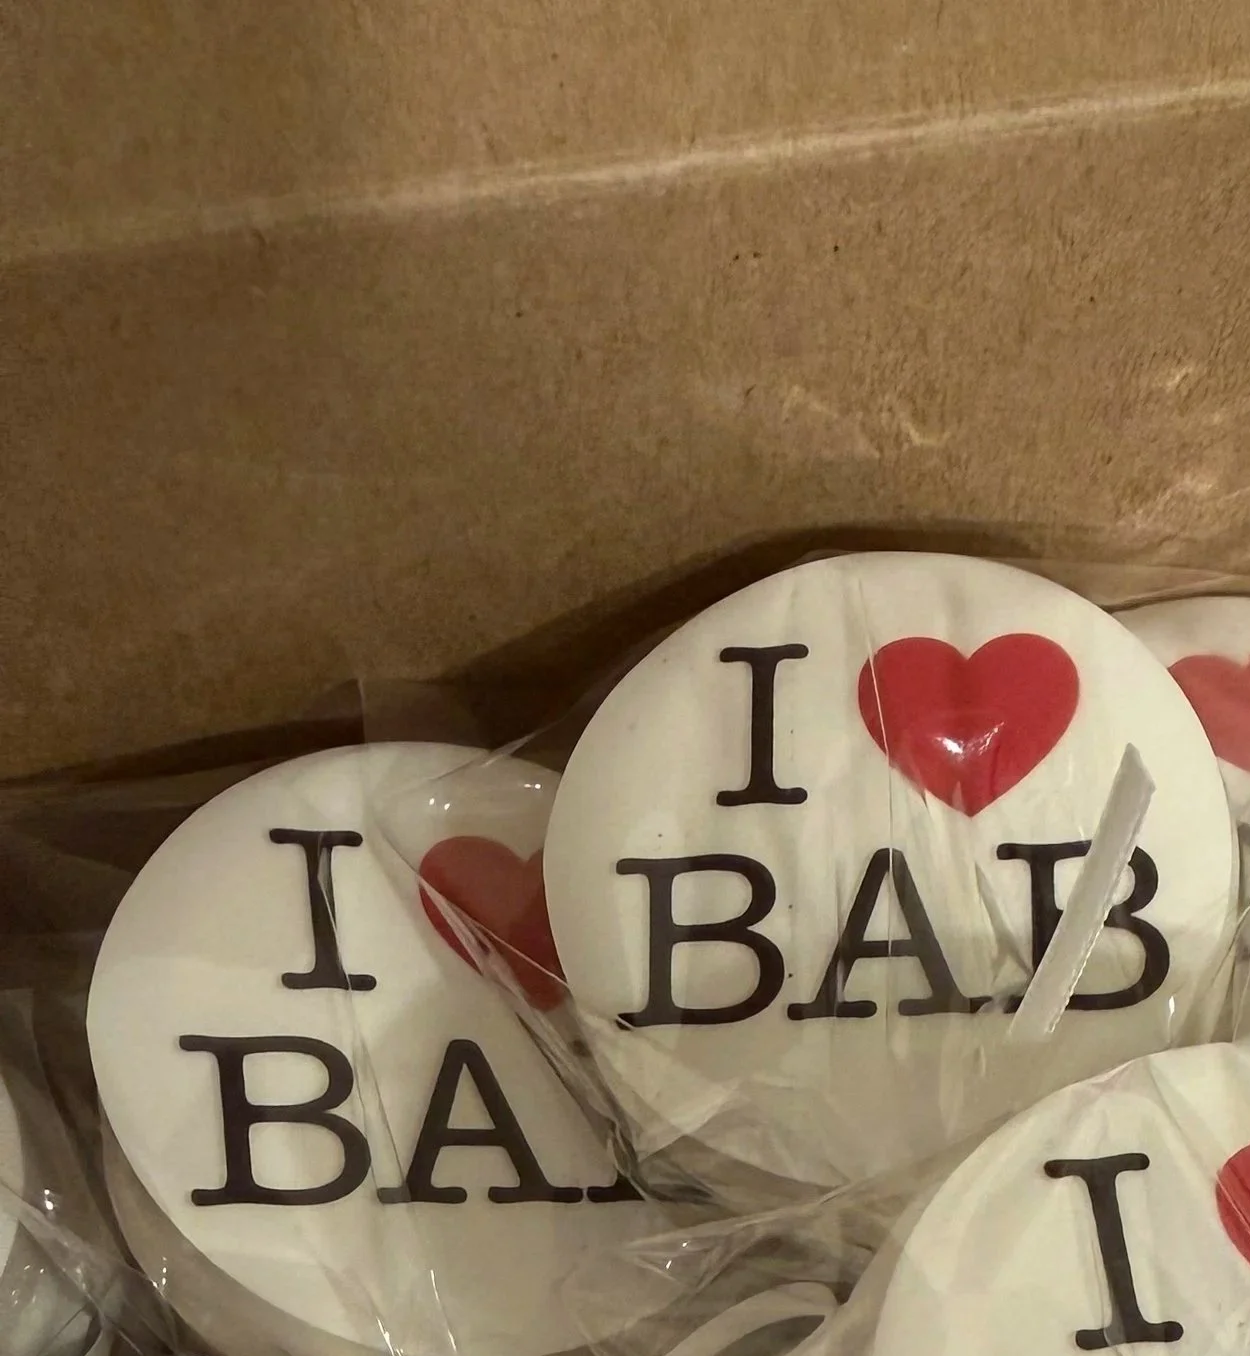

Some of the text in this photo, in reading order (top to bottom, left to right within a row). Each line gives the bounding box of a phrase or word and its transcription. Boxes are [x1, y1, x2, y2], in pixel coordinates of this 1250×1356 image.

[716, 643, 810, 807] I
[268, 828, 377, 991] I
[615, 841, 1171, 1030] BAB
[178, 1034, 646, 1205] BA
[1043, 1152, 1184, 1351] I
